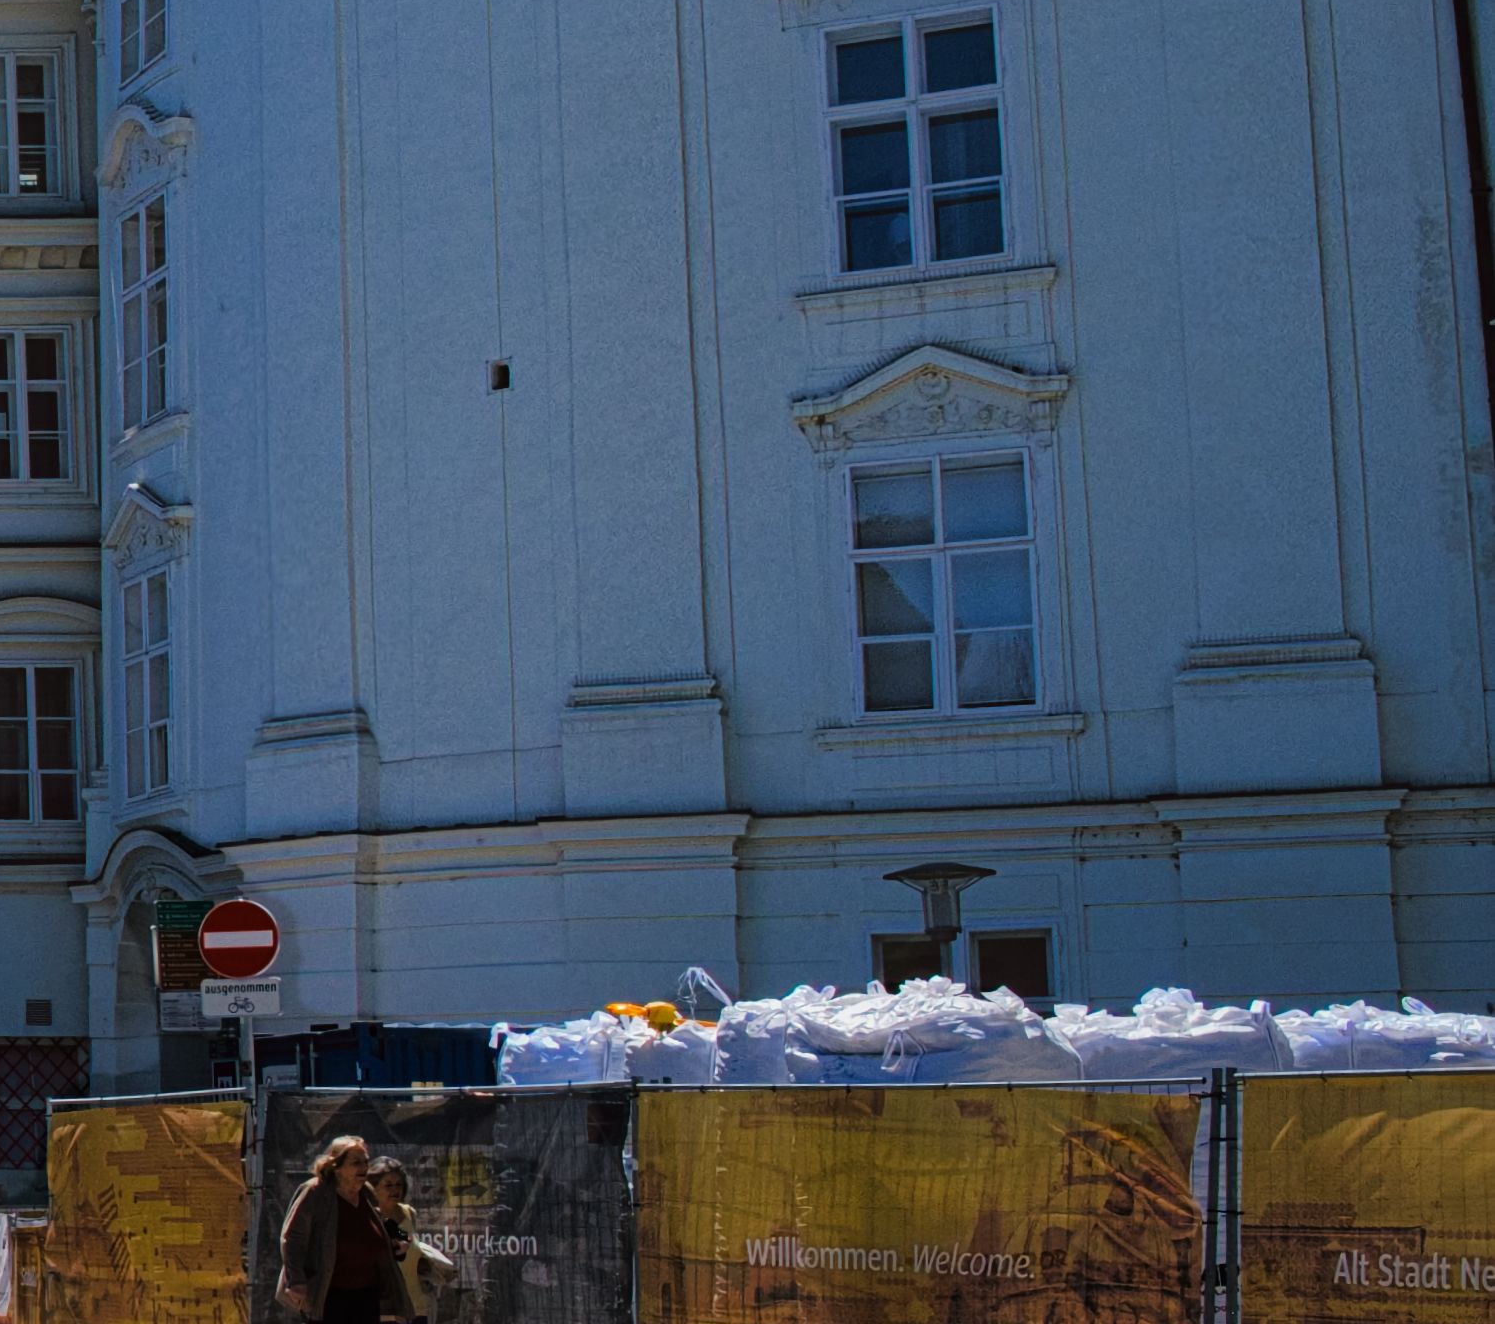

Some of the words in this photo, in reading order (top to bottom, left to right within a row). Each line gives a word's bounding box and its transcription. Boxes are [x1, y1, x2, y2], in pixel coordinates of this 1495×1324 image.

[204, 982, 277, 996] ausgenommen
[746, 1236, 905, 1273] Willkommen.
[913, 1242, 1036, 1280] Welcome.
[1333, 1249, 1370, 1287] Alt
[1378, 1251, 1452, 1291] Stadt
